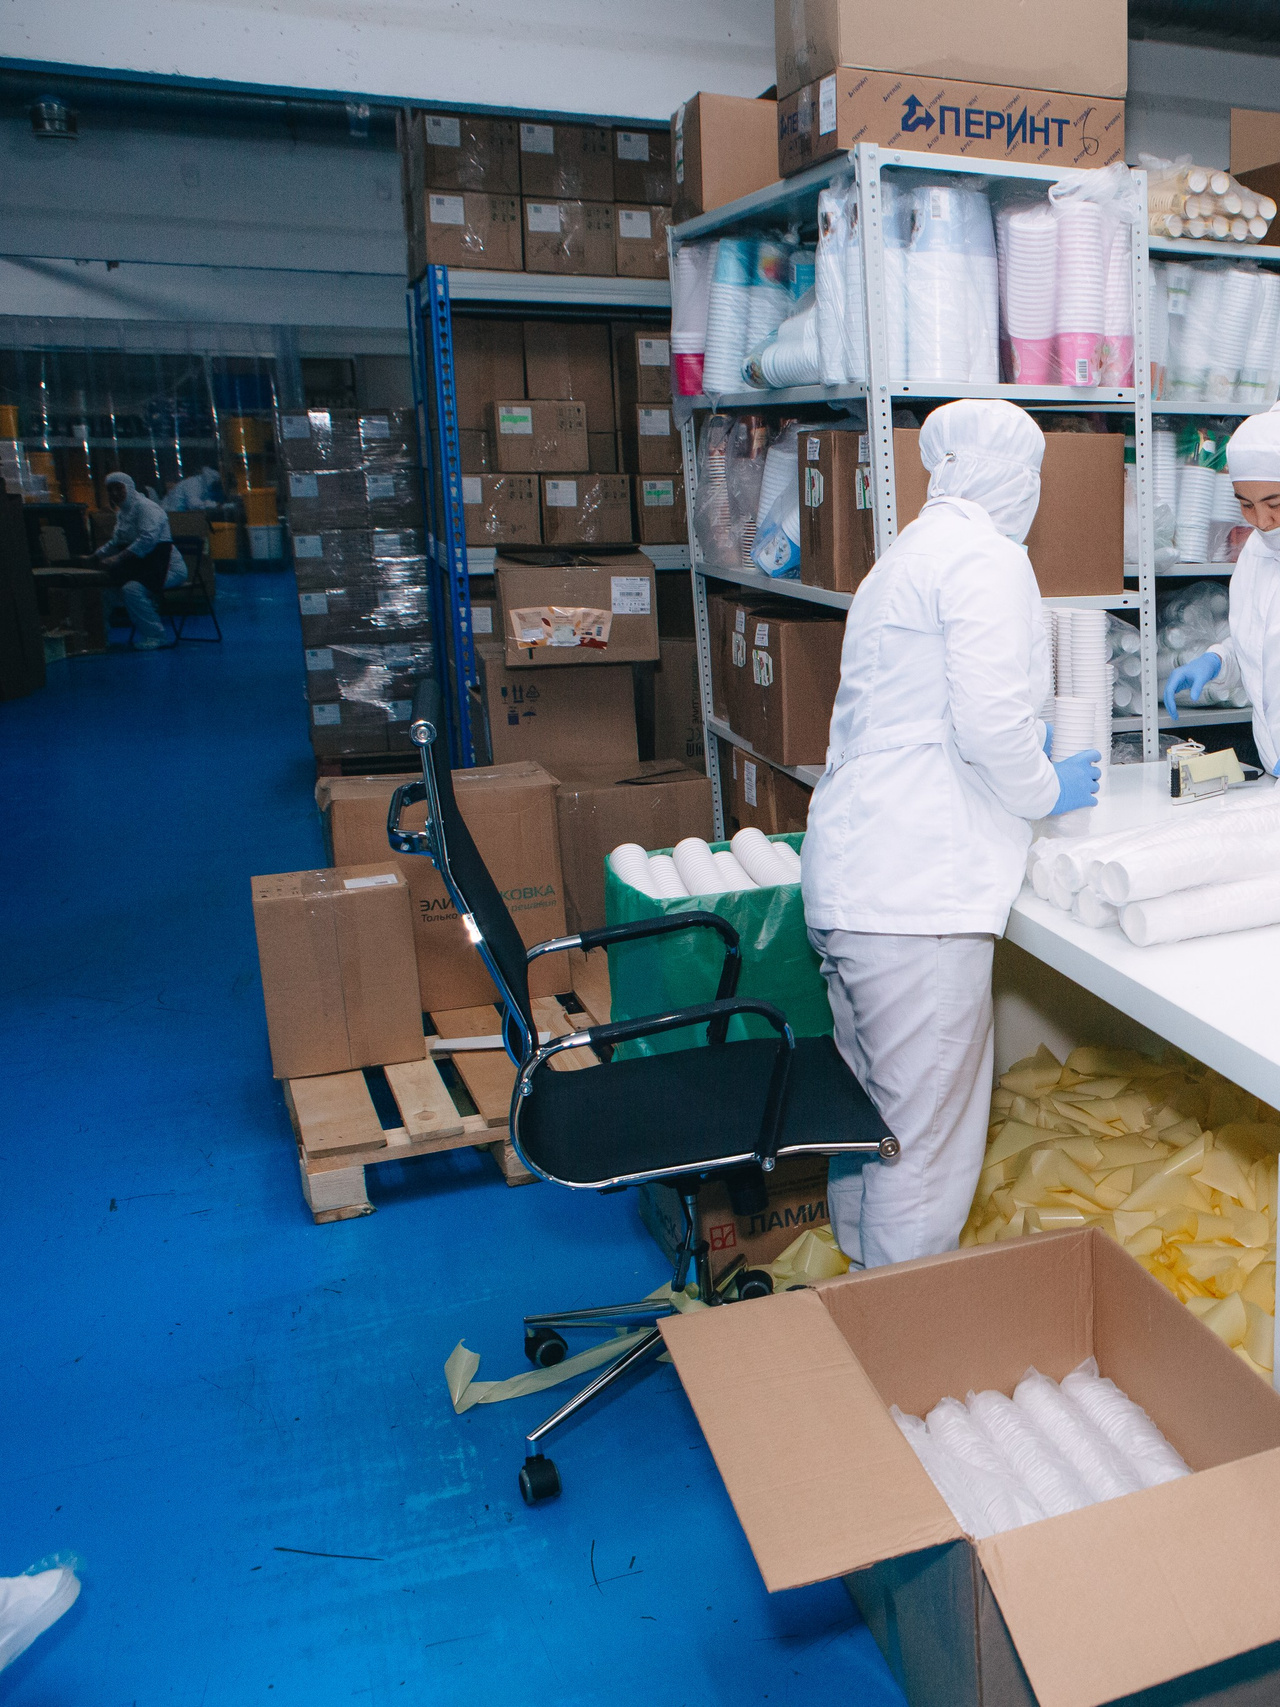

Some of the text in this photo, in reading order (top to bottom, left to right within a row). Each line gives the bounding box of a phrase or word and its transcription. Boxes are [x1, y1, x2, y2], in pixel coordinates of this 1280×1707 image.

[940, 105, 1070, 149] ПЕРИНТ
[421, 912, 458, 923] Только
[748, 1201, 829, 1236] ЛАМИ
